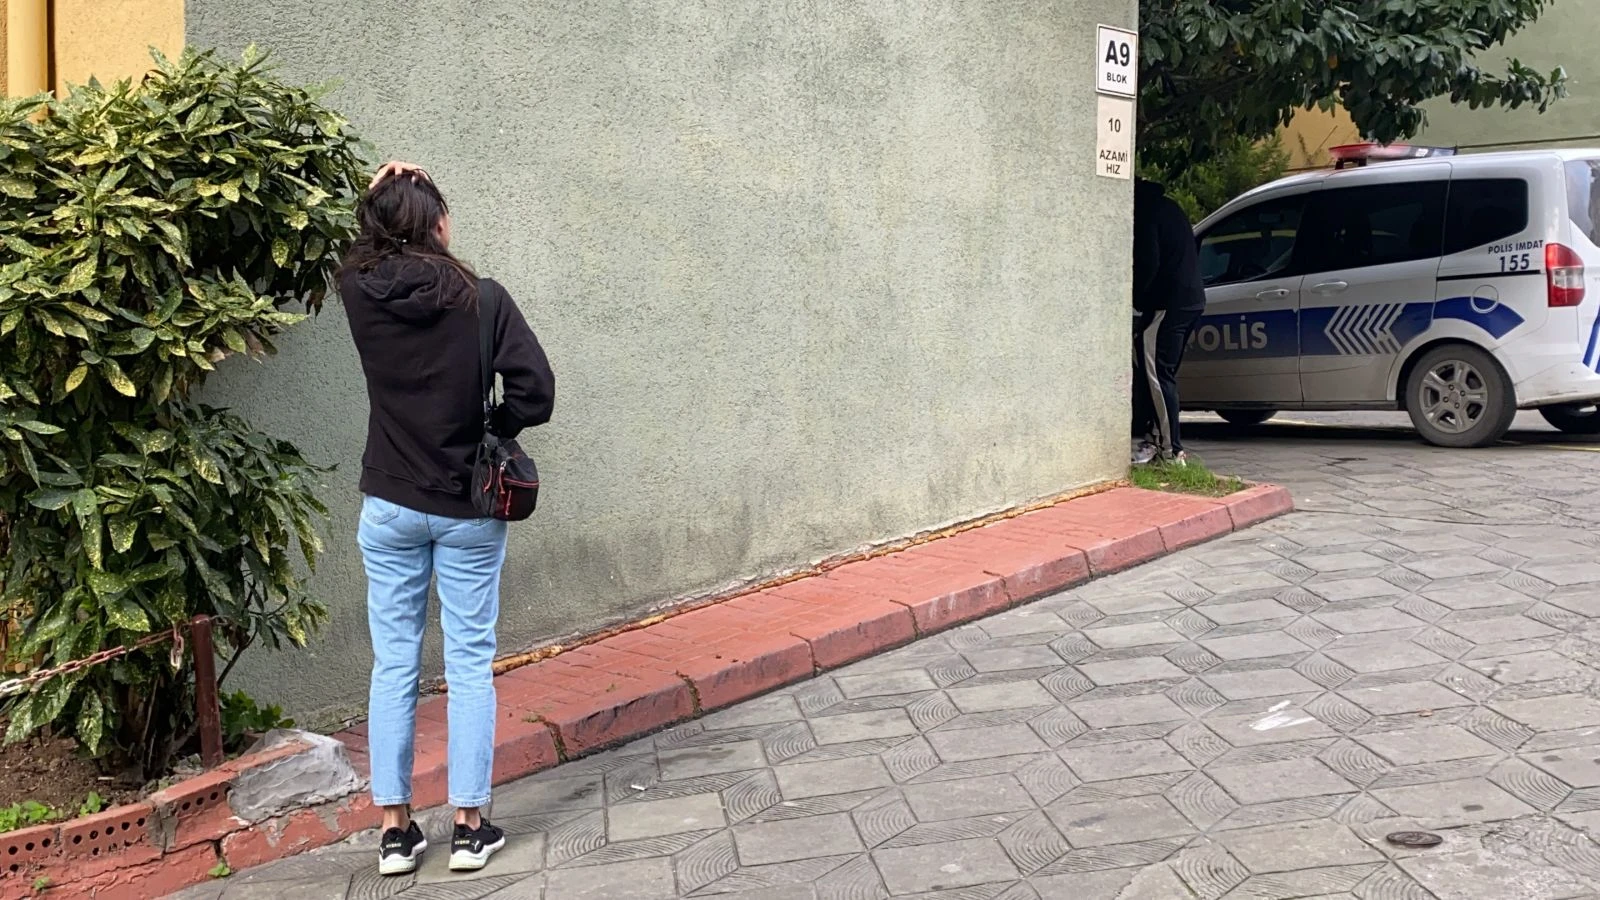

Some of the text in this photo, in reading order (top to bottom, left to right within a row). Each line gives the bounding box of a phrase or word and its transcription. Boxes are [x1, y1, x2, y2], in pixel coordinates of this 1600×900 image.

[1105, 39, 1130, 67] A9
[1106, 72, 1127, 84] BLOK
[1108, 117, 1121, 133] 10
[1106, 164, 1121, 175] HIZ
[1499, 253, 1530, 272] 155
